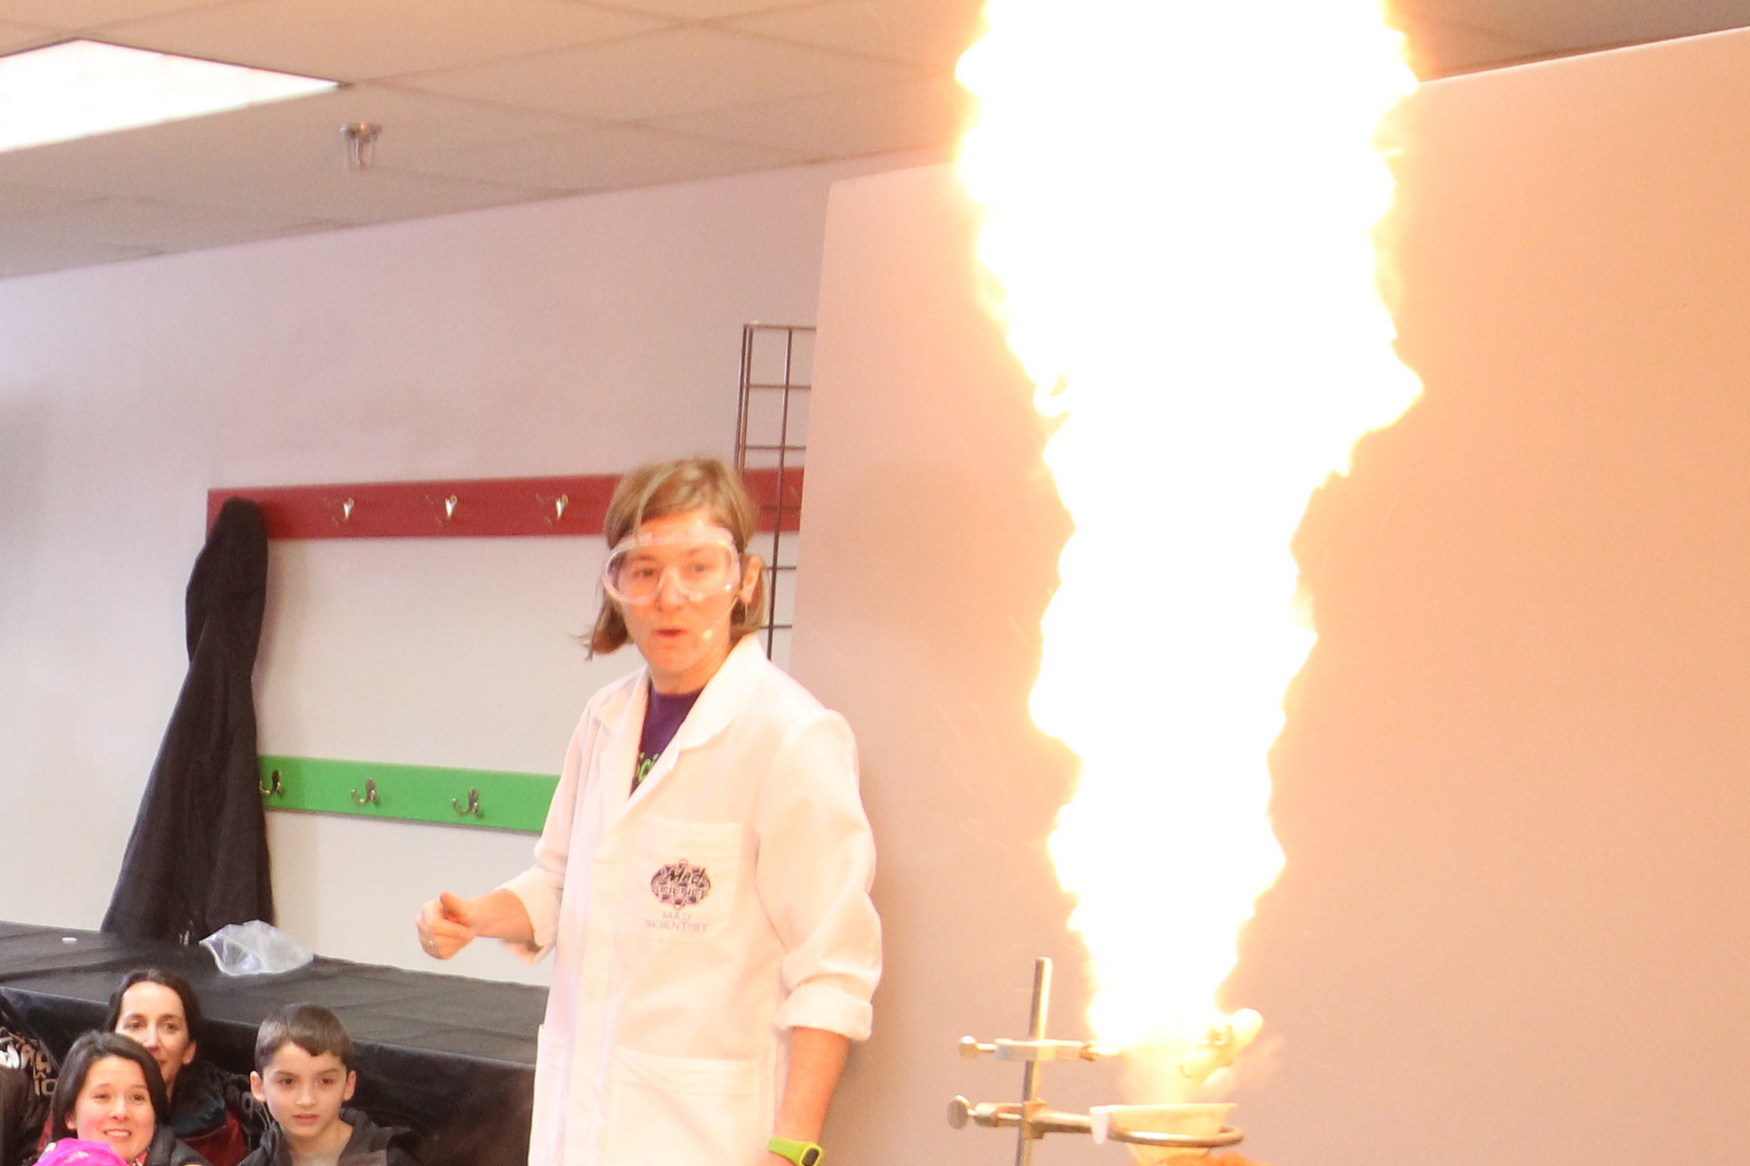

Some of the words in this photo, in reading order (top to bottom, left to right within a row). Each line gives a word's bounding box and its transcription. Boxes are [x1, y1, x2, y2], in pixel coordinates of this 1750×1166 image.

[664, 866, 706, 885] Mad
[652, 884, 710, 898] SCIENCE
[662, 910, 691, 920] MAD
[645, 919, 709, 931] SCIENTIST
